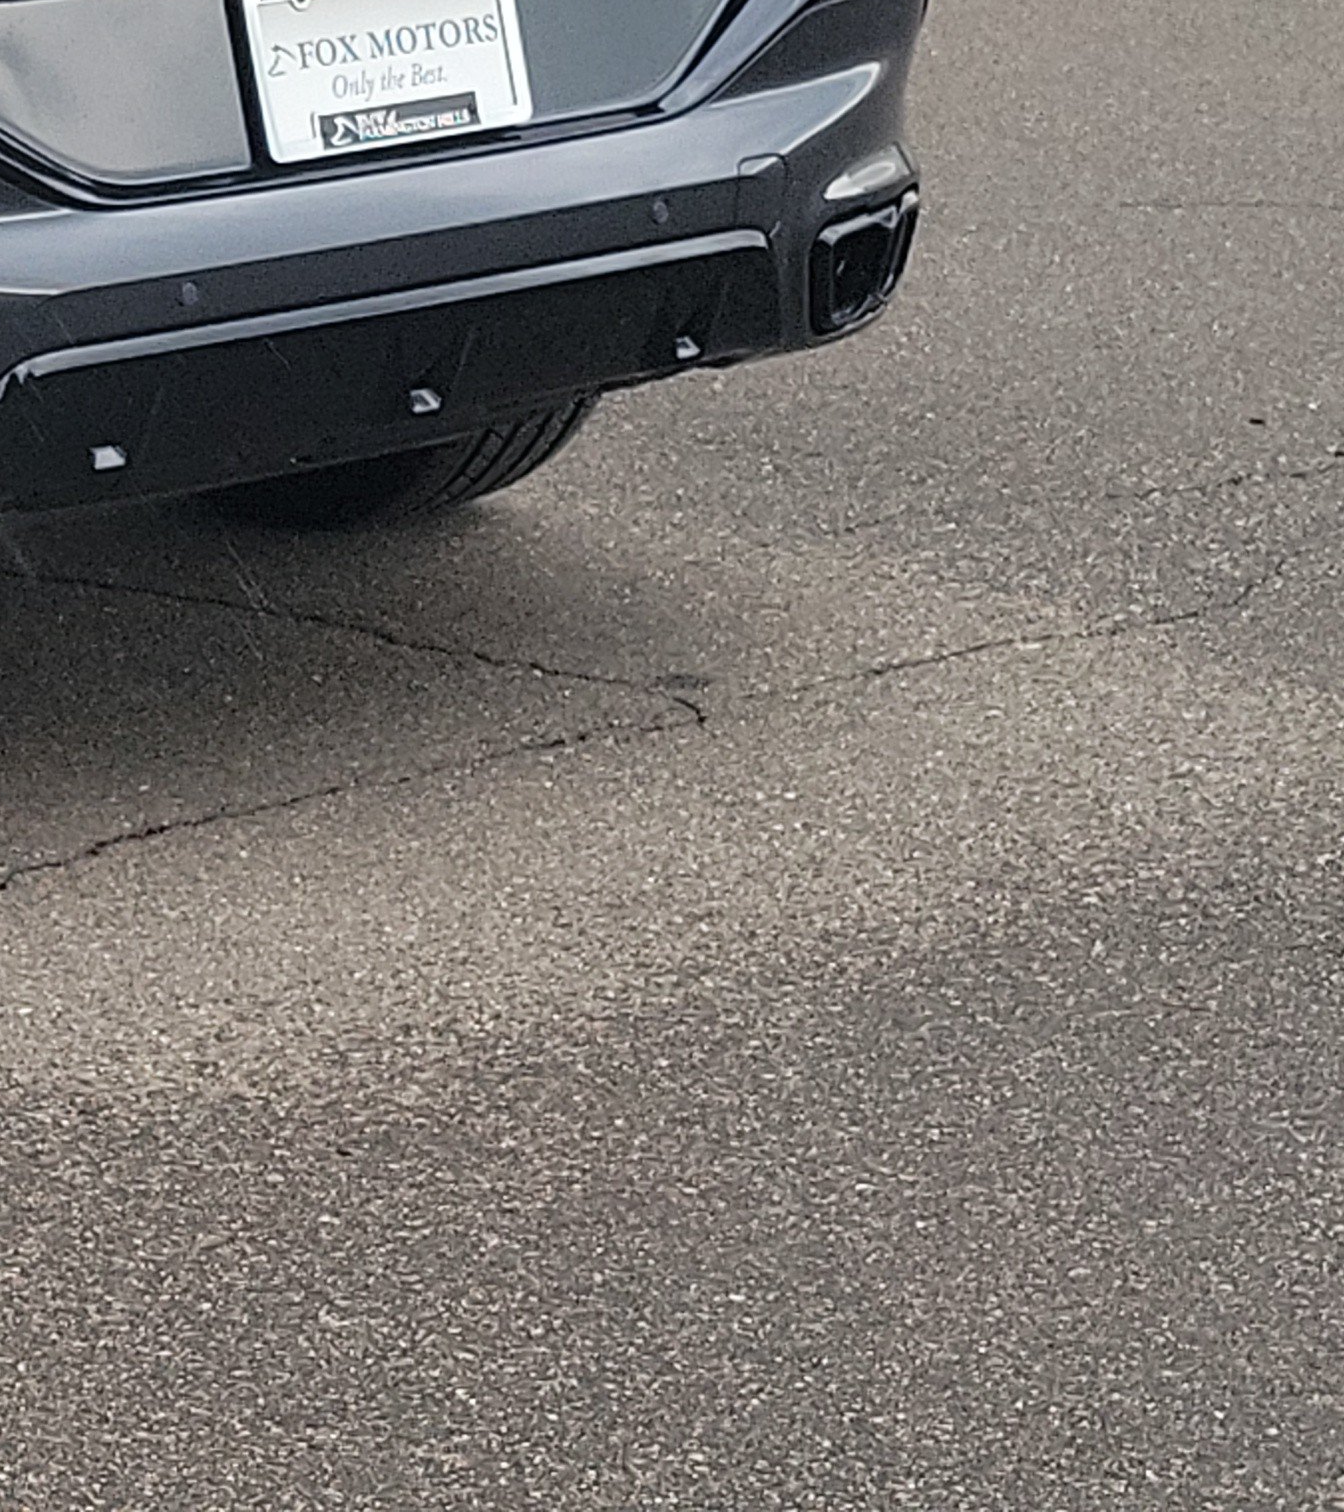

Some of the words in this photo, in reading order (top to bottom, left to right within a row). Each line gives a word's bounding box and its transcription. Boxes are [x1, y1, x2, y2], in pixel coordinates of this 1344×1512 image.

[297, 34, 361, 70] FOX
[367, 13, 499, 59] MOTORS
[332, 69, 374, 102] Only
[381, 65, 406, 90] the
